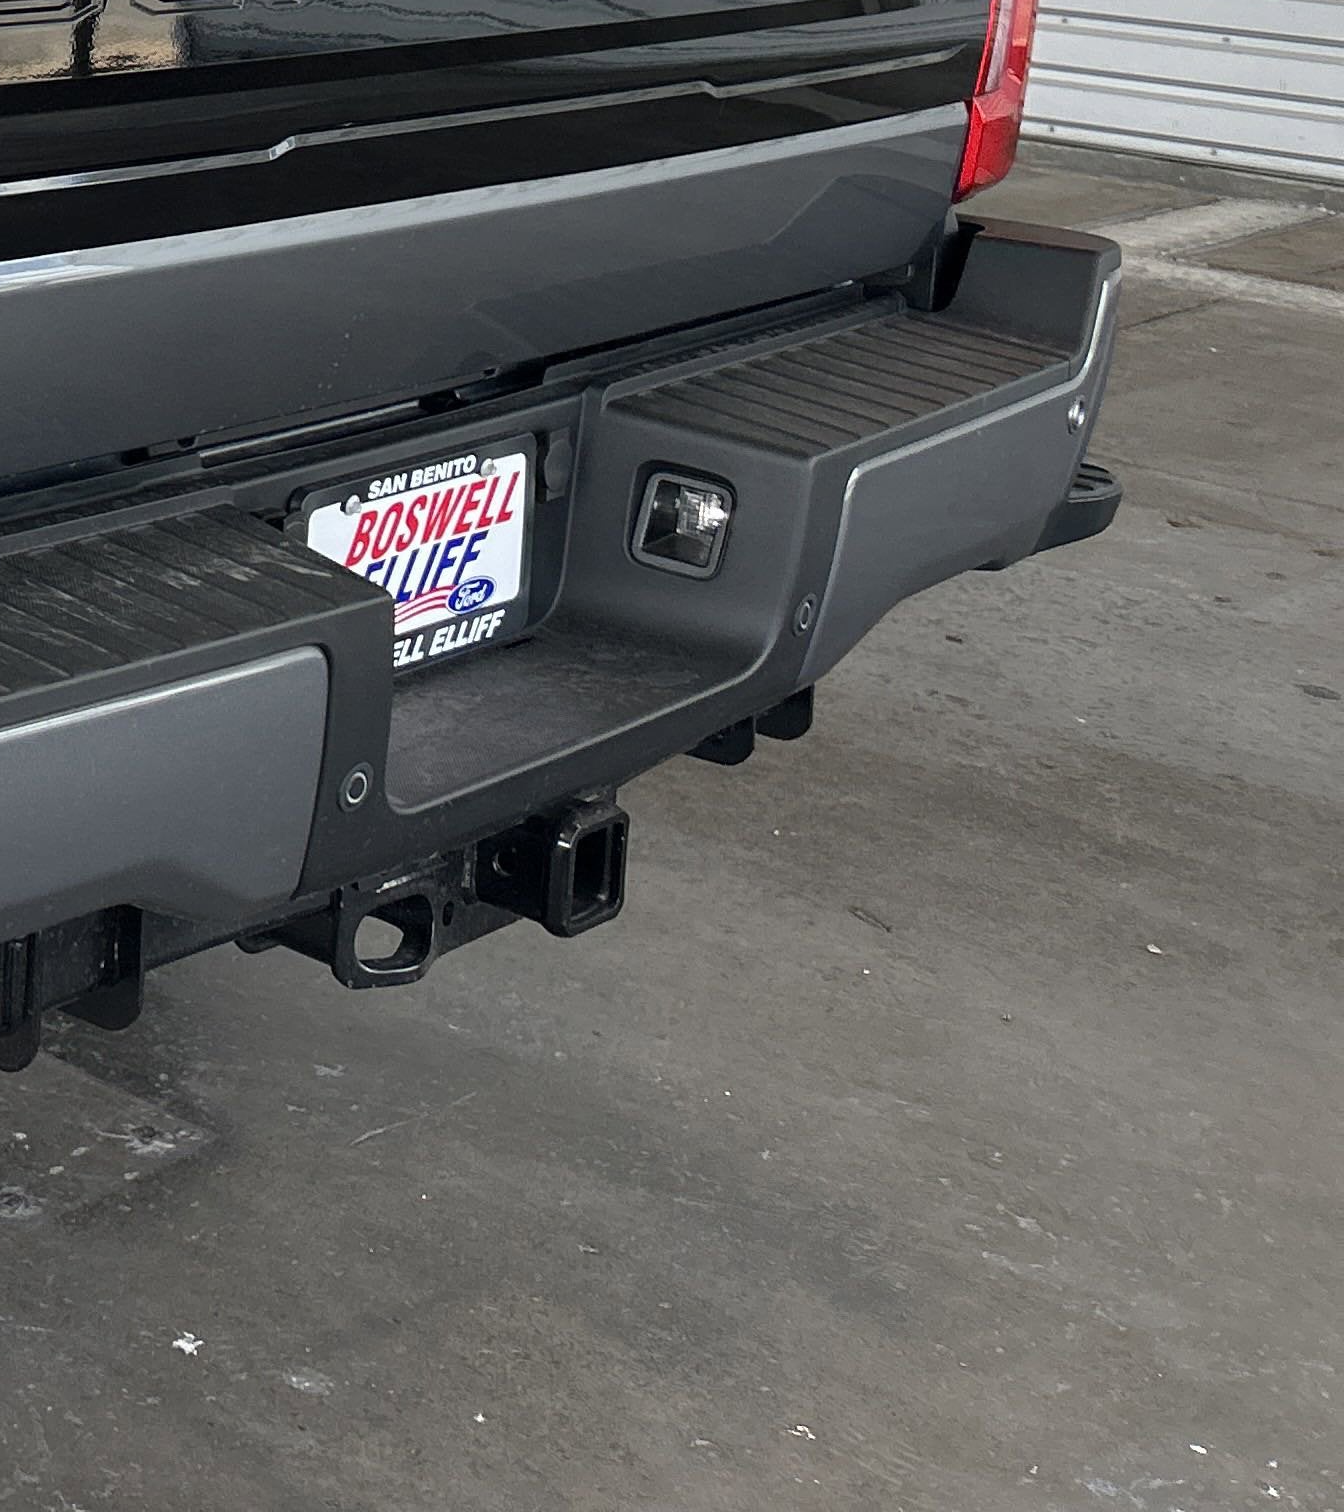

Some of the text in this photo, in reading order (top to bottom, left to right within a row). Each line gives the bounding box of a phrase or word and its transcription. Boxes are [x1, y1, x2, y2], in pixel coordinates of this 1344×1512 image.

[367, 454, 477, 500] SAN BENITO
[345, 470, 521, 568] BOSWELL
[455, 582, 488, 610] Ford
[429, 609, 506, 655] ELLIFF
